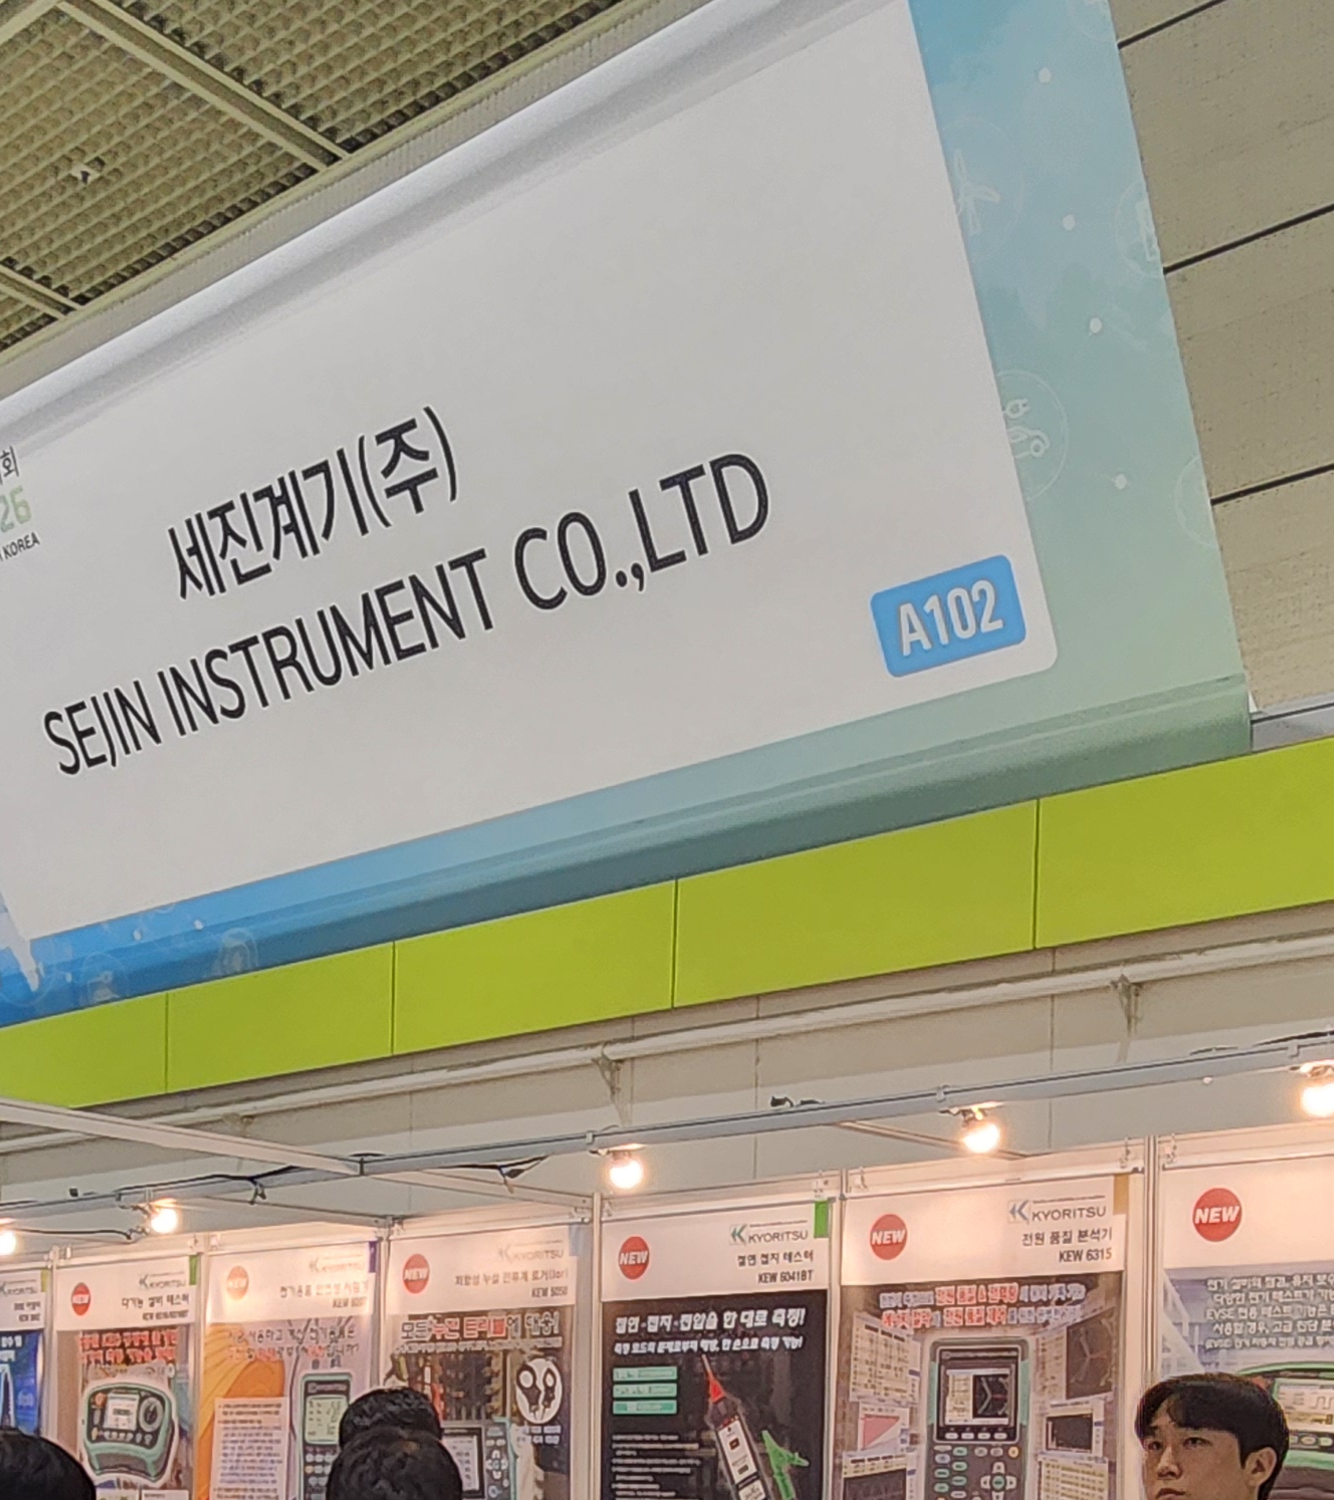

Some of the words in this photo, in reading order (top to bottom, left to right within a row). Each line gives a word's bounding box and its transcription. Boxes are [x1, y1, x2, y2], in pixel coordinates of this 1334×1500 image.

[165, 407, 461, 602] 세진계기(주)
[4, 532, 40, 559] KOREA
[43, 680, 160, 779] SEJIN
[163, 550, 491, 739] INSTRUMENT
[512, 452, 769, 610] CO.,LTD
[897, 577, 1002, 658] A102
[1031, 1206, 1107, 1222] KYORITSU
[1194, 1205, 1241, 1225] NEW
[748, 1230, 808, 1244] KYORITSU
[871, 1229, 906, 1246] NEW
[619, 1250, 648, 1265] NEW
[1059, 1250, 1083, 1263] KEW
[1086, 1247, 1112, 1262] 6315
[758, 1272, 778, 1284] KEW
